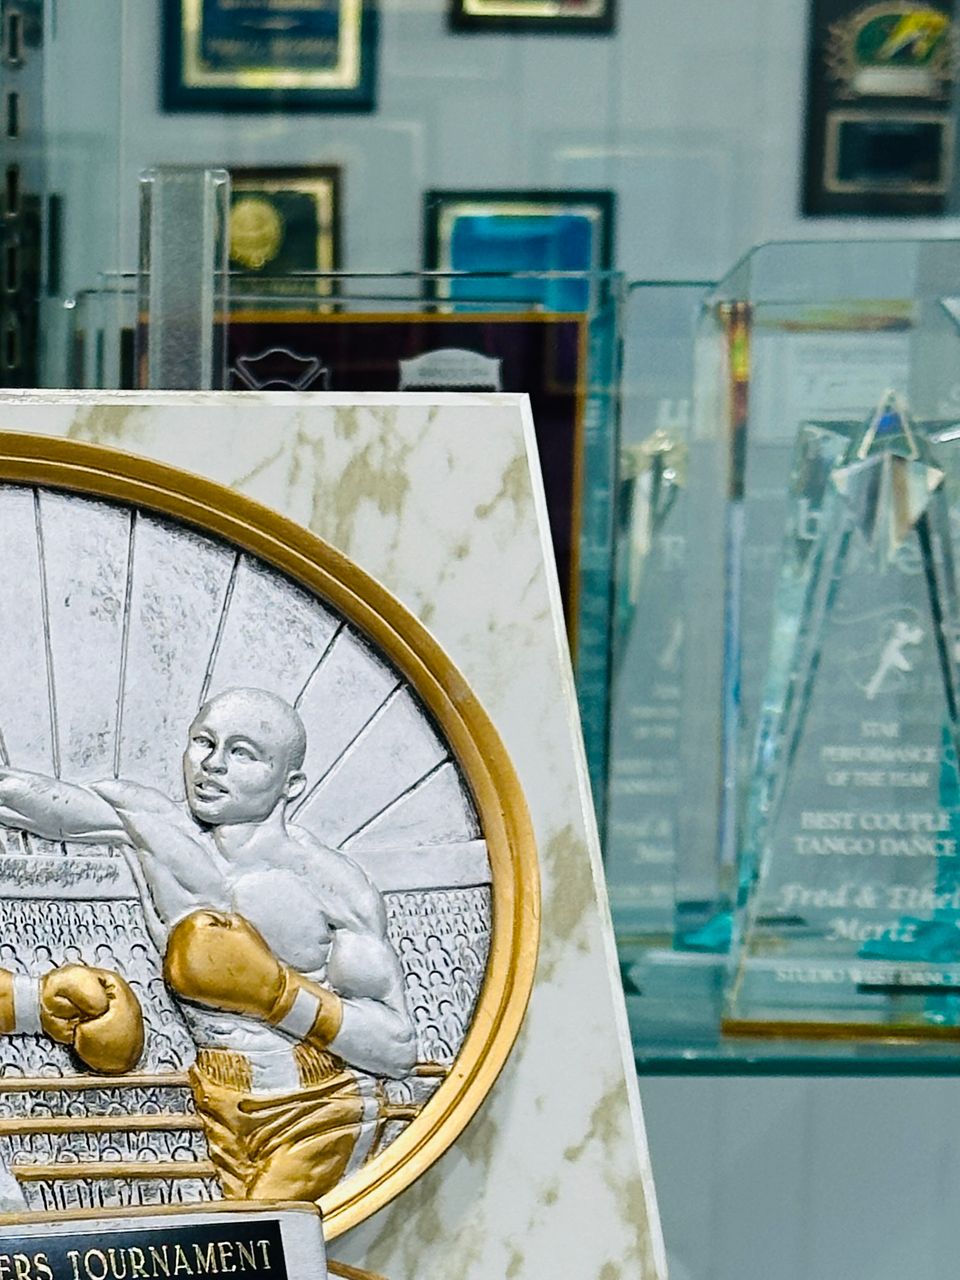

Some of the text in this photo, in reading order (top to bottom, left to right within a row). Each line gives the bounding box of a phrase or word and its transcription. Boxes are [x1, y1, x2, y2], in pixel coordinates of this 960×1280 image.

[801, 812, 951, 832] BEST COUPLE
[794, 836, 958, 858] TANGO DANCE
